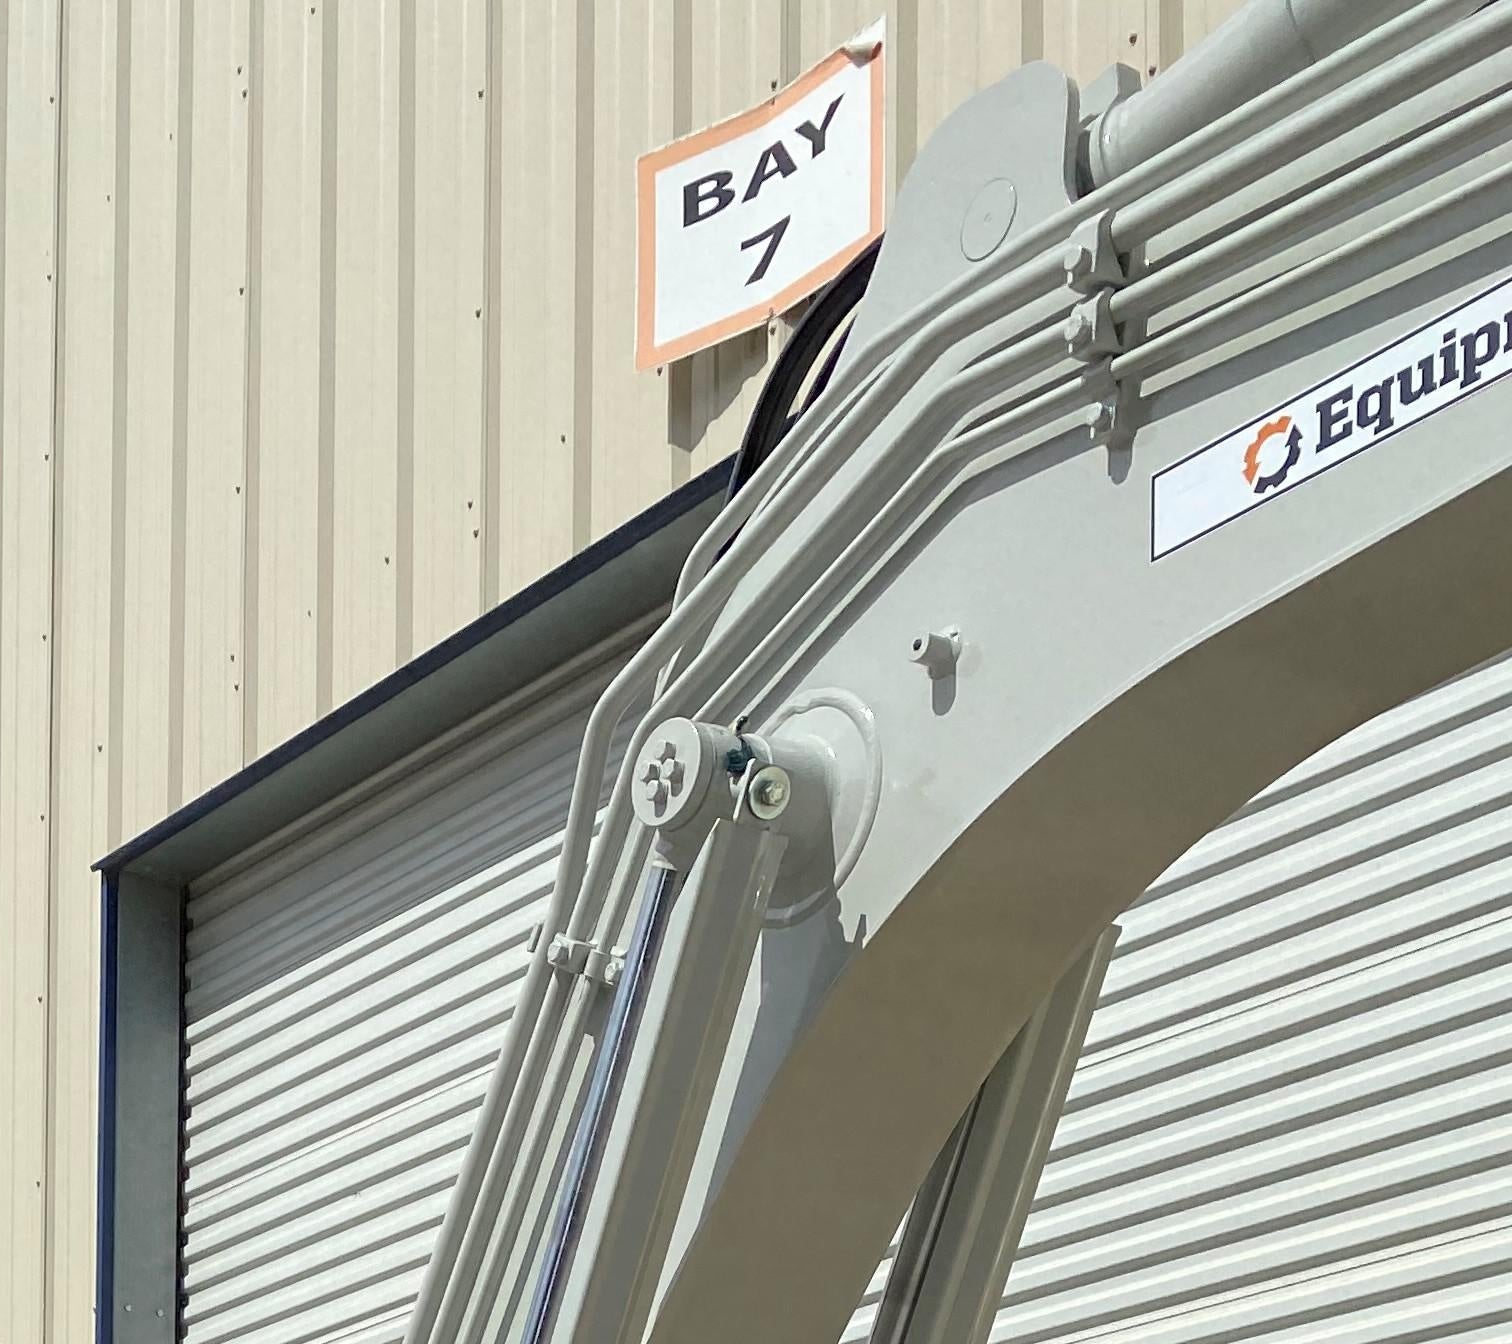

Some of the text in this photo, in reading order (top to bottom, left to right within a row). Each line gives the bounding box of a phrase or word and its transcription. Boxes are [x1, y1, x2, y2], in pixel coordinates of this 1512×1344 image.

[683, 93, 845, 228] BAY
[740, 214, 791, 287] 7
[1315, 310, 1512, 454] Equip
